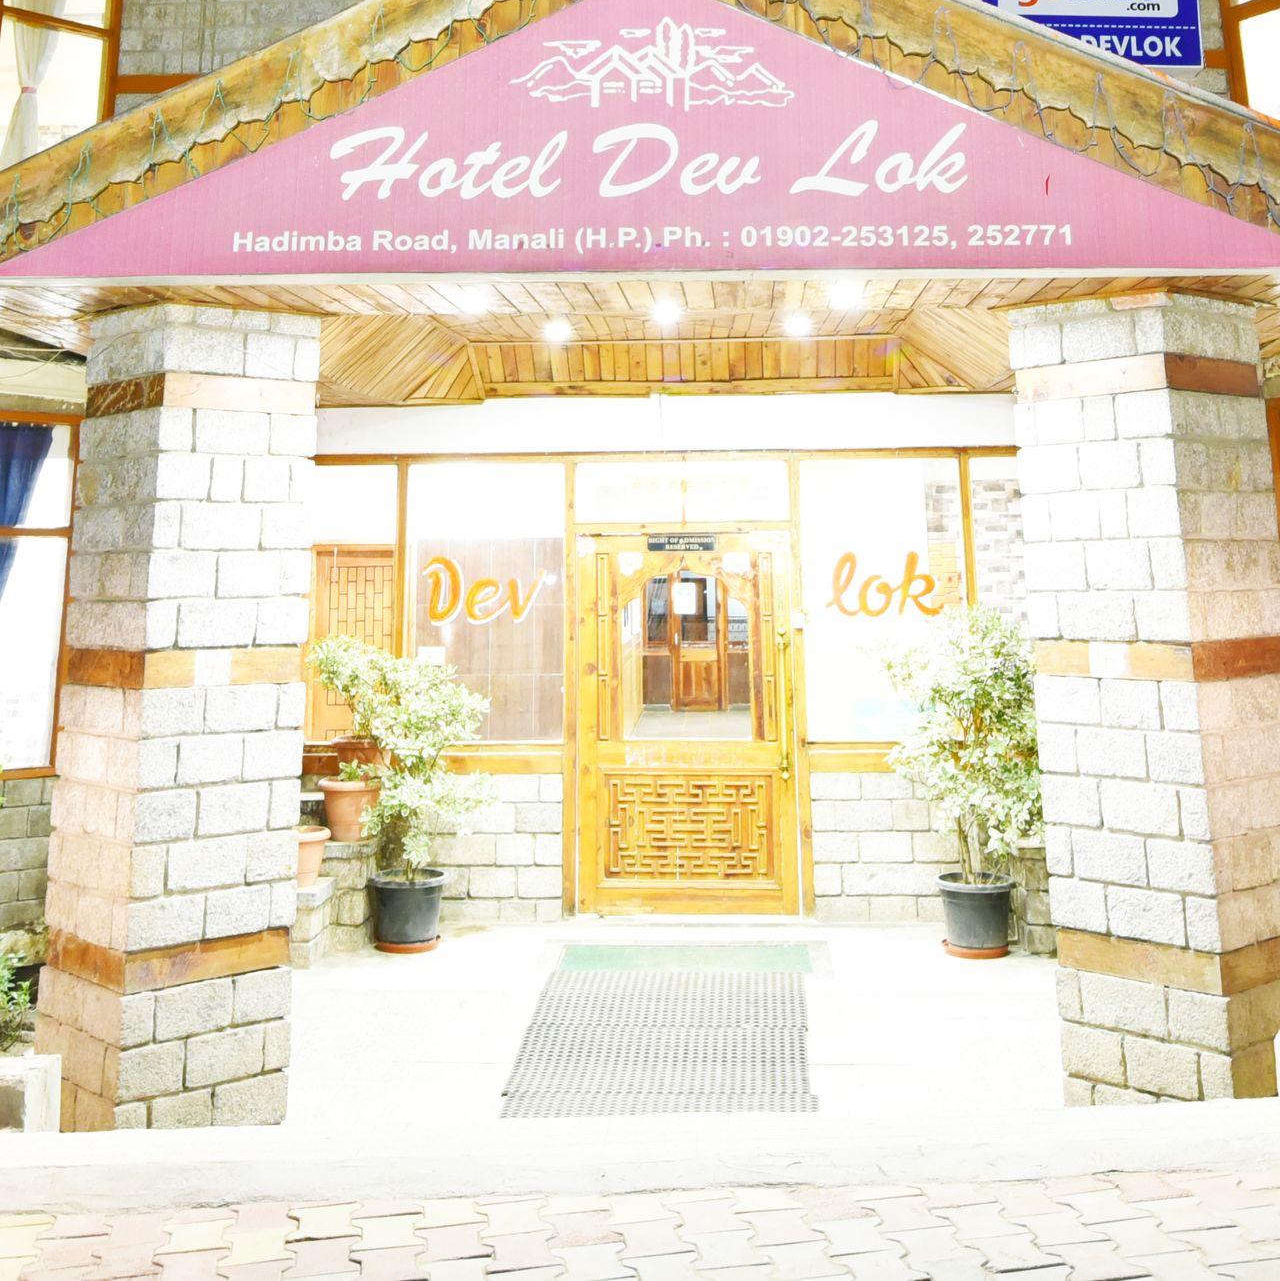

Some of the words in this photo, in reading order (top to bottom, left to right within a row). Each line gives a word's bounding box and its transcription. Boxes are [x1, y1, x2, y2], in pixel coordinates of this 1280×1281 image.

[1126, 2, 1161, 11] .com
[329, 126, 568, 201] Hotel
[592, 123, 762, 198] Dev
[788, 119, 969, 197] Lok
[232, 231, 362, 253] Hadimba
[371, 229, 458, 255] Road,
[468, 228, 565, 250] Manali
[740, 224, 957, 250] 01902-253125,
[967, 224, 1074, 246] 252771
[421, 556, 546, 627] Dev
[825, 551, 944, 617] lok
